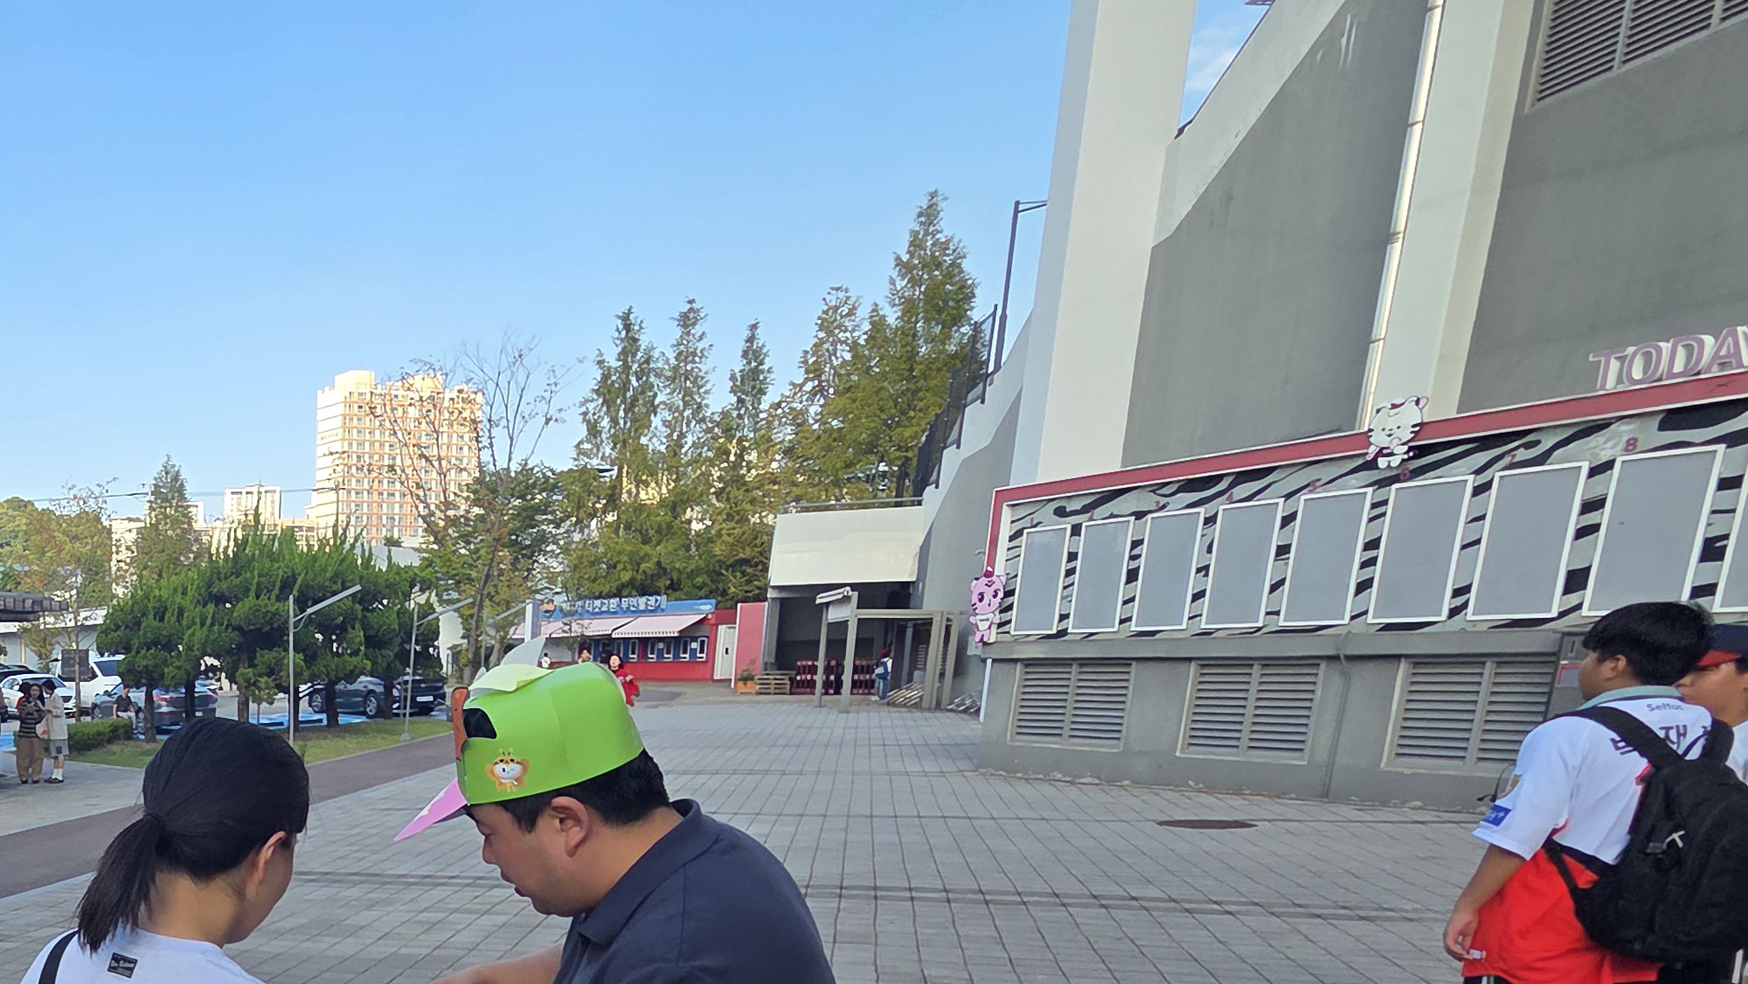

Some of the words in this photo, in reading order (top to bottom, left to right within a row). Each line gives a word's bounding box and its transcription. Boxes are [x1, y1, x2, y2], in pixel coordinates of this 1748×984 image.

[1589, 325, 1748, 391] TODA
[1625, 437, 1638, 453] 8
[621, 595, 667, 612] 무인발권기
